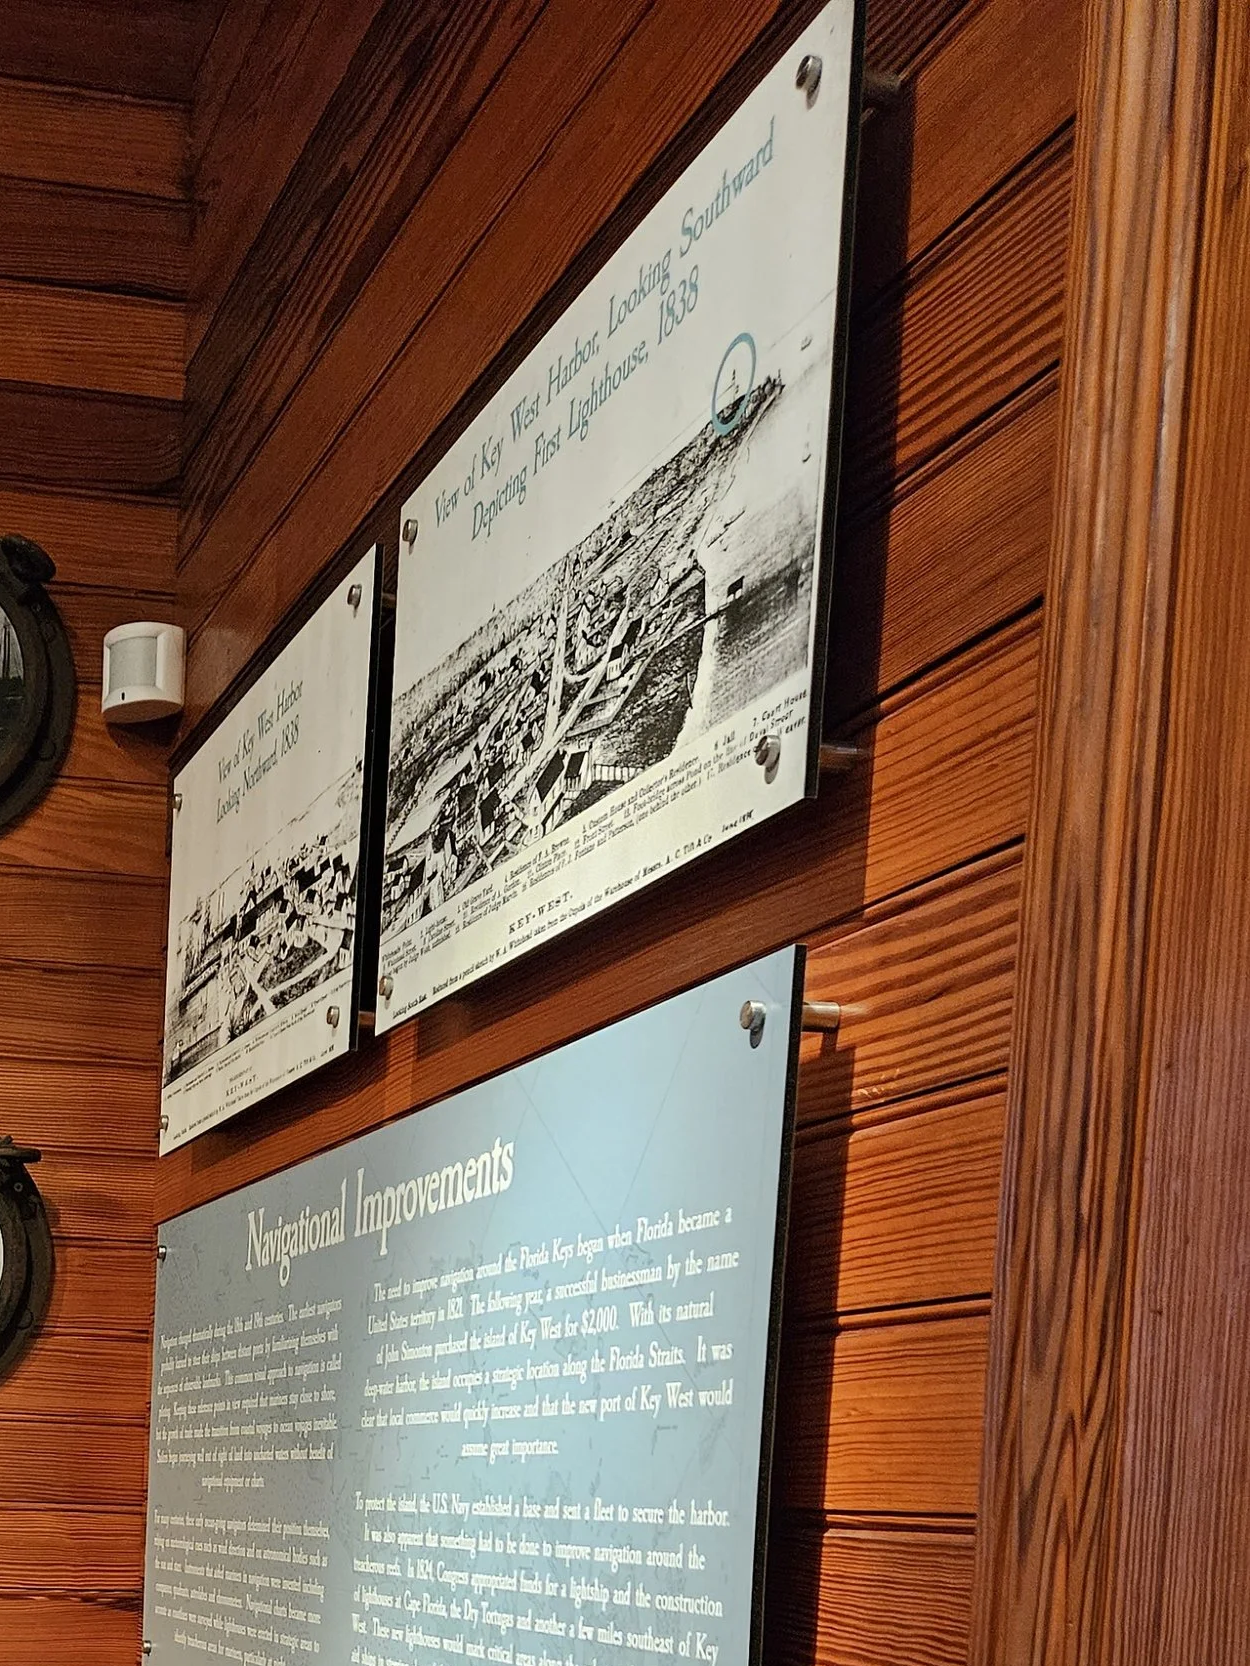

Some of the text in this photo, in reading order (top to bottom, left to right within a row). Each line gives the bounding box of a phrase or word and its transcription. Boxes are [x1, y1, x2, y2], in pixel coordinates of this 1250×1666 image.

[434, 115, 774, 527] View of Key West Harbor, Looking Southward
[471, 265, 699, 540] Depicting First Lighthouse, 1838
[216, 787, 240, 824] Looking
[280, 713, 299, 757] 1838
[217, 756, 232, 783] View
[233, 738, 241, 768] of
[241, 728, 255, 760] Key
[257, 708, 274, 740] West
[245, 1135, 516, 1288] Navigational Improvements
[503, 1250, 517, 1273] the
[519, 1242, 549, 1269] Florida
[551, 1237, 574, 1268] Keys
[576, 1233, 604, 1264] began
[607, 1223, 632, 1249] when
[636, 1212, 673, 1243] Florida
[677, 1208, 720, 1234] became
[600, 1266, 662, 1291] businessman
[666, 1253, 681, 1287] by
[684, 1249, 703, 1276] the
[706, 1251, 739, 1272] name
[507, 1291, 714, 1350] of Key West for $2,000. With its natural
[525, 1358, 560, 1380] location
[561, 1353, 587, 1384] along
[590, 1348, 606, 1373] the
[608, 1344, 644, 1371] Florida
[648, 1340, 685, 1368] Straits.
[696, 1335, 707, 1362] It
[711, 1343, 732, 1360] was
[523, 1394, 539, 1418] and
[541, 1393, 559, 1416] that
[561, 1391, 576, 1415] the
[578, 1398, 597, 1414] new
[599, 1394, 621, 1422] port
[624, 1385, 637, 1411] of
[639, 1384, 661, 1418] Key
[665, 1381, 693, 1408] West
[698, 1378, 733, 1406] would
[354, 1490, 364, 1510] To
[450, 1493, 470, 1522] Navy
[522, 1495, 541, 1518] base
[543, 1496, 560, 1519] and
[562, 1502, 581, 1520] sent
[593, 1496, 614, 1521] fleet
[617, 1503, 629, 1522] to
[632, 1507, 664, 1524] secure
[668, 1498, 685, 1525] the
[689, 1499, 729, 1526] harbor.
[477, 1530, 706, 1572] had to be done to improve navigation around the
[544, 1572, 558, 1596] for
[569, 1576, 609, 1611] lightship
[612, 1581, 631, 1605] and
[634, 1582, 651, 1608] the
[655, 1594, 723, 1617] construction
[462, 1598, 479, 1629] Dry
[516, 1608, 532, 1631] and
[577, 1615, 594, 1640] few
[596, 1621, 623, 1646] miles
[626, 1626, 673, 1653] southeast
[678, 1631, 691, 1657] of
